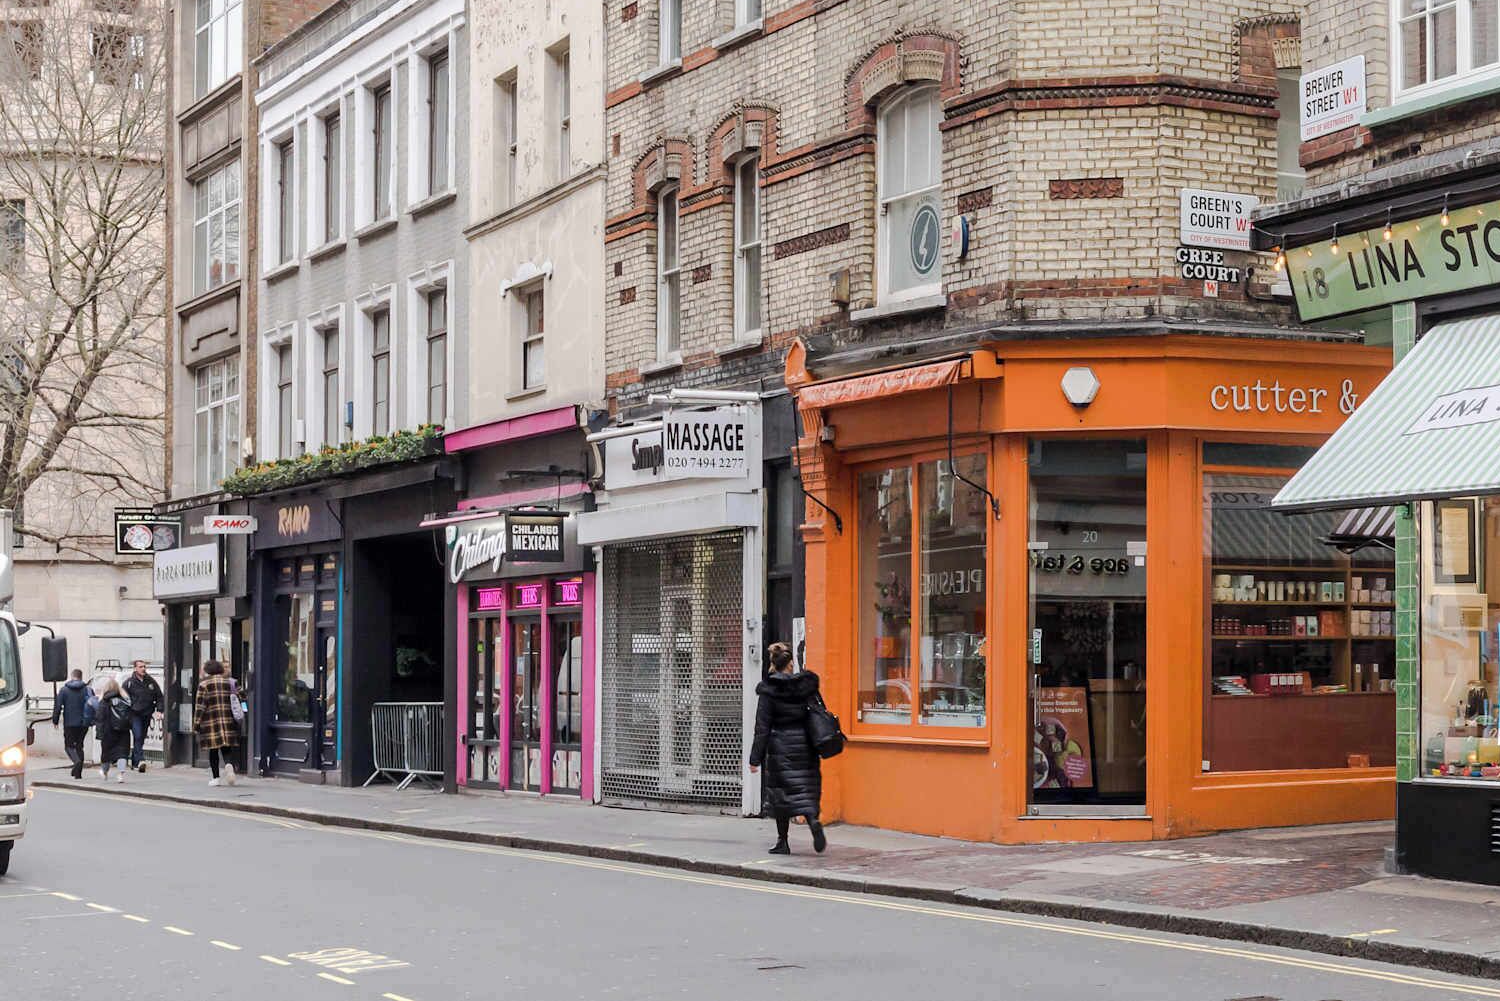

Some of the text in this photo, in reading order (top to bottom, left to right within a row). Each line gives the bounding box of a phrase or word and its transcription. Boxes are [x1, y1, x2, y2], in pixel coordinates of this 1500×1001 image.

[1306, 70, 1343, 98] BREWER
[1306, 87, 1358, 118] STREET W1
[1191, 195, 1242, 214] GREEN'S
[1190, 213, 1248, 232] COURT W
[1213, 237, 1249, 247] WESTMINSTE
[1176, 248, 1224, 265] GREE
[1182, 264, 1240, 282] COURT
[1302, 267, 1330, 301] 18
[1347, 239, 1426, 291] LINA
[1210, 378, 1359, 415] cutter &
[1428, 397, 1488, 423] LINA
[667, 422, 744, 451] MASSAGE
[668, 457, 744, 468] 020 7494 2277
[213, 519, 249, 530] RAMO
[278, 504, 310, 539] RAMO
[512, 525, 558, 535] CHILANGO
[512, 535, 559, 550] MEXICAN
[1082, 531, 1098, 543] 20
[451, 527, 506, 584] Chilang
